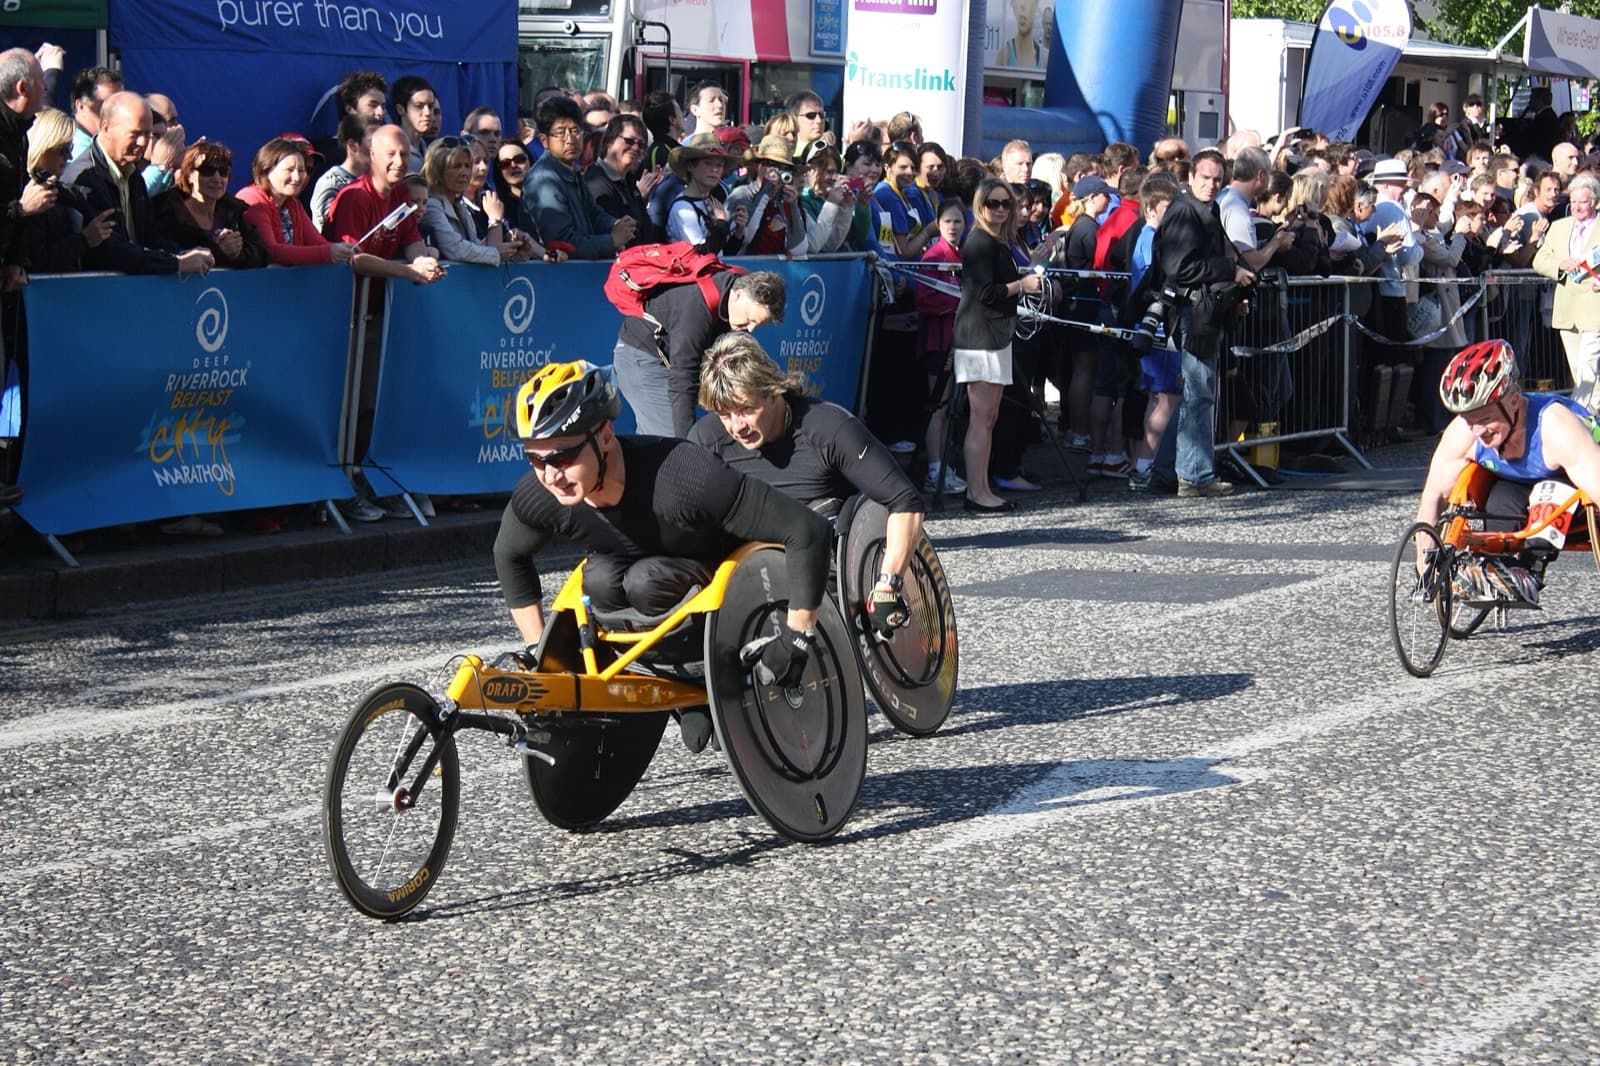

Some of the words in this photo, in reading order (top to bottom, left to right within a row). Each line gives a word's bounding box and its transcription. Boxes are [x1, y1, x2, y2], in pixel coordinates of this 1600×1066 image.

[218, 0, 302, 31] purer
[314, 0, 381, 32] than
[390, 12, 443, 41] you
[1366, 25, 1405, 37] 105.8
[860, 67, 956, 91] Translink
[500, 337, 534, 348] DEEP
[796, 328, 822, 338] DEEP
[780, 339, 829, 357] RIVERROCK
[193, 355, 229, 369] DEEP
[480, 350, 552, 369] RIVERROCK
[164, 367, 248, 392] RIVERROCK
[170, 389, 235, 409] BELFAST
[561, 405, 581, 432] MET
[478, 443, 525, 463] MARAT
[152, 463, 236, 487] MARATHON
[486, 682, 525, 698] DRAFT
[387, 867, 430, 903] CORIMA
